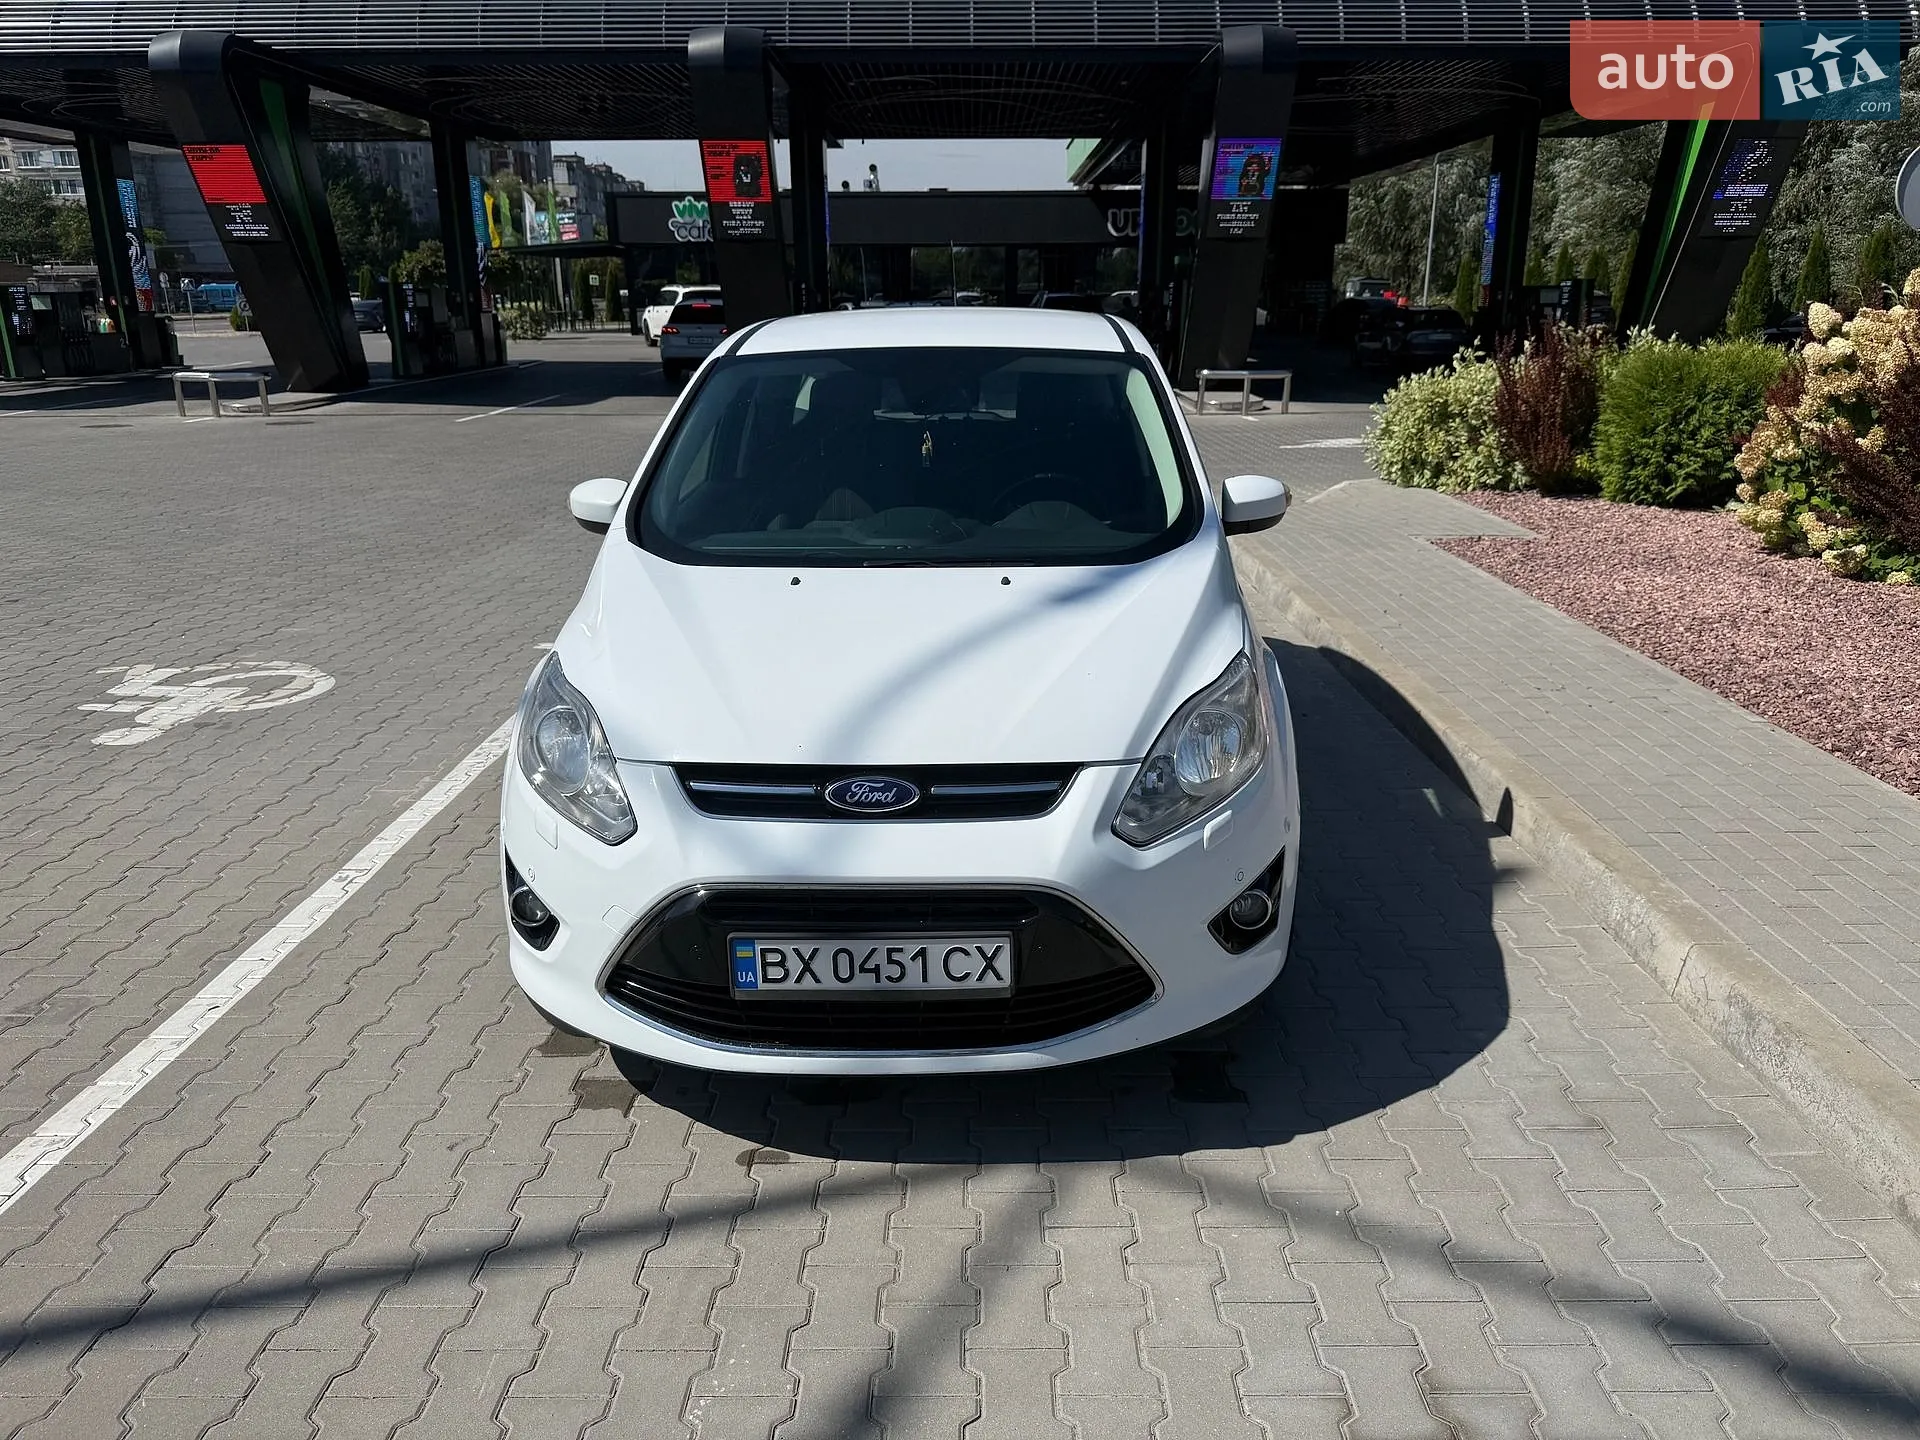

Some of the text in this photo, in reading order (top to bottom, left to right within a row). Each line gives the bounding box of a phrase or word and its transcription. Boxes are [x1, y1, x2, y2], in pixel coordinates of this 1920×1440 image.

[672, 197, 709, 219] viv
[846, 781, 898, 803] Ford
[759, 944, 1004, 983] BX 0451 CX
[738, 972, 755, 983] UA
